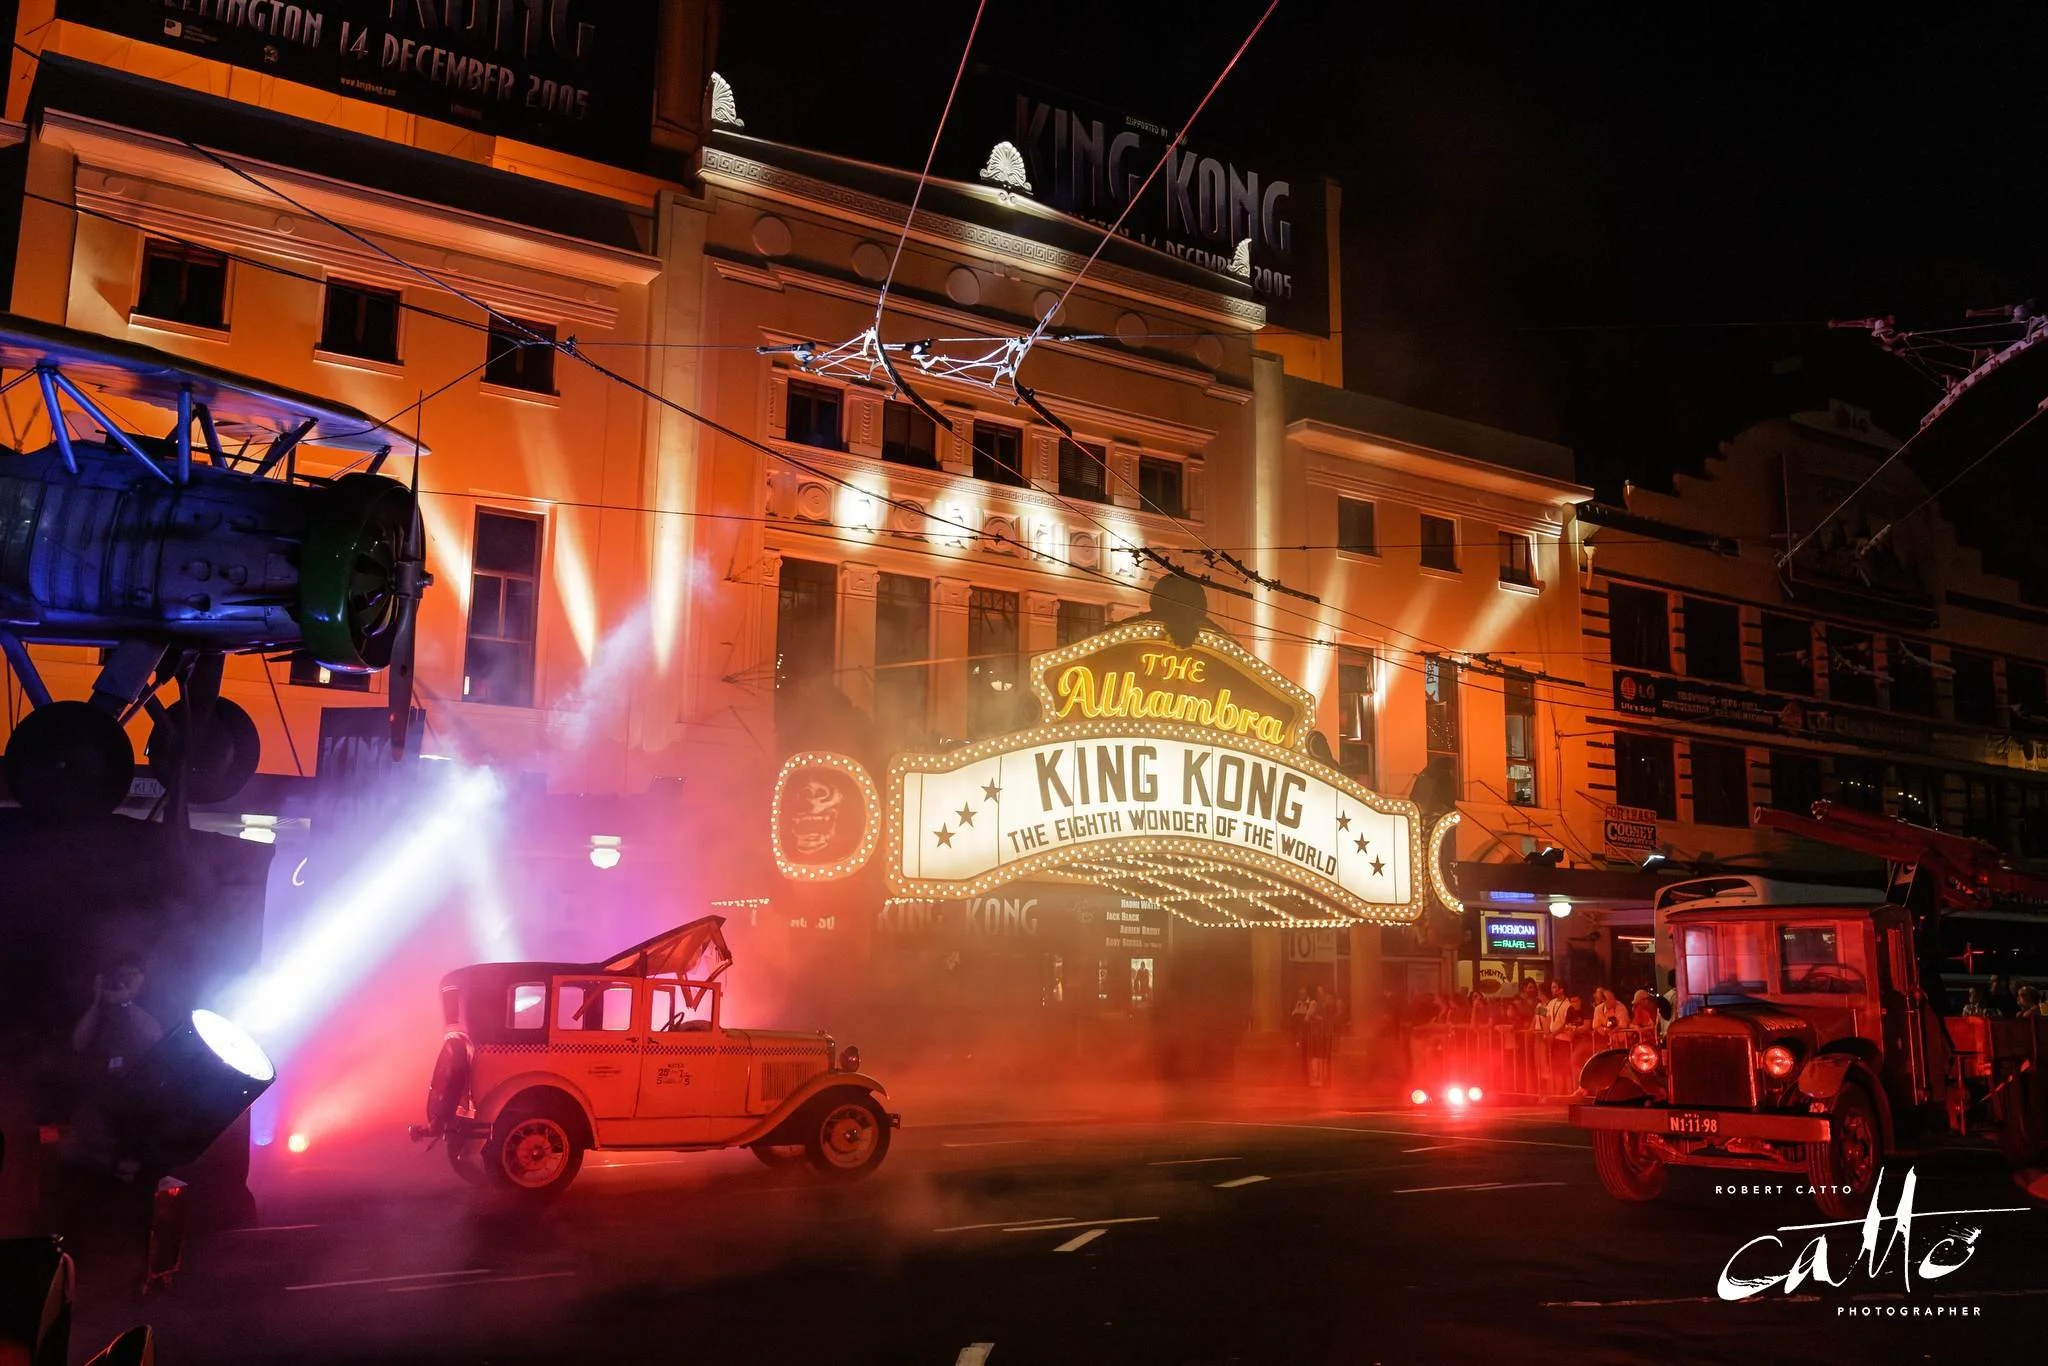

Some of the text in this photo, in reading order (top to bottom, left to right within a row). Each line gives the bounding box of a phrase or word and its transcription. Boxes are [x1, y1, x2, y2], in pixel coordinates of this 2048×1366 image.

[339, 21, 368, 59] 14
[382, 33, 516, 101] DECEMBER
[526, 75, 591, 121] 2005
[1016, 93, 1292, 252] KING KONG
[1141, 653, 1206, 683] THE
[1639, 684, 1656, 700] LG
[1057, 666, 1284, 744] Alhambra
[1033, 745, 1307, 829] KING KONG
[1007, 810, 1338, 877] THE EIGHTH WONDER OF THE WORLD
[965, 897, 1038, 937] KONG
[1491, 924, 1536, 936] PHOENICIAN
